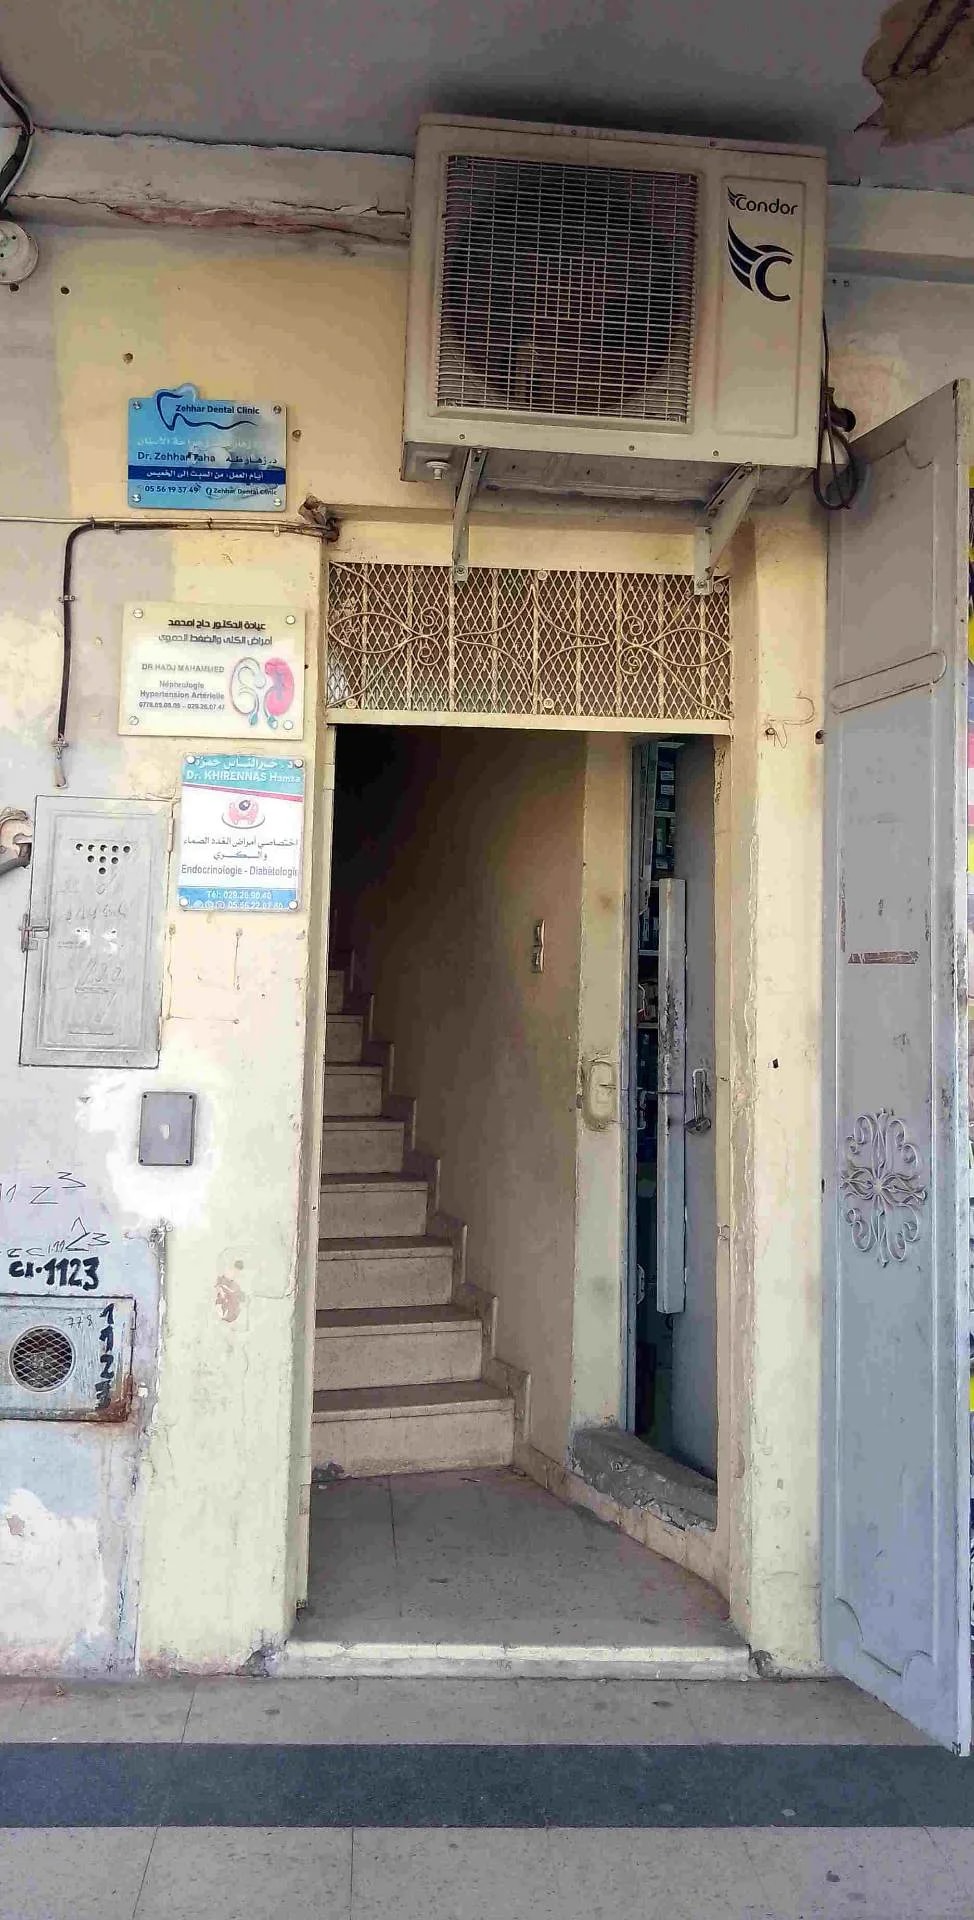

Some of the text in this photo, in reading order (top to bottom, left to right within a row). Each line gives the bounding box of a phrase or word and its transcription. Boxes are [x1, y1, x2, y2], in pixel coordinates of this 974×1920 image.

[735, 194, 799, 215] Condor
[175, 404, 260, 415] Zehhar Dental Clinic
[137, 451, 152, 460] Dr.
[154, 452, 190, 462] Zehhar
[146, 468, 176, 479] الخميس
[144, 485, 155, 493] 05
[156, 485, 166, 493] 56
[213, 487, 236, 495] Zehhar
[196, 618, 210, 629] حاج
[212, 619, 243, 630] الدكتور
[243, 621, 266, 632] عيادة
[159, 680, 205, 690] Néphrologie
[139, 689, 190, 699] Hypertension
[186, 770, 301, 783] Dr. KHIRENNAS Hamza
[181, 864, 243, 877] Endocrinologie
